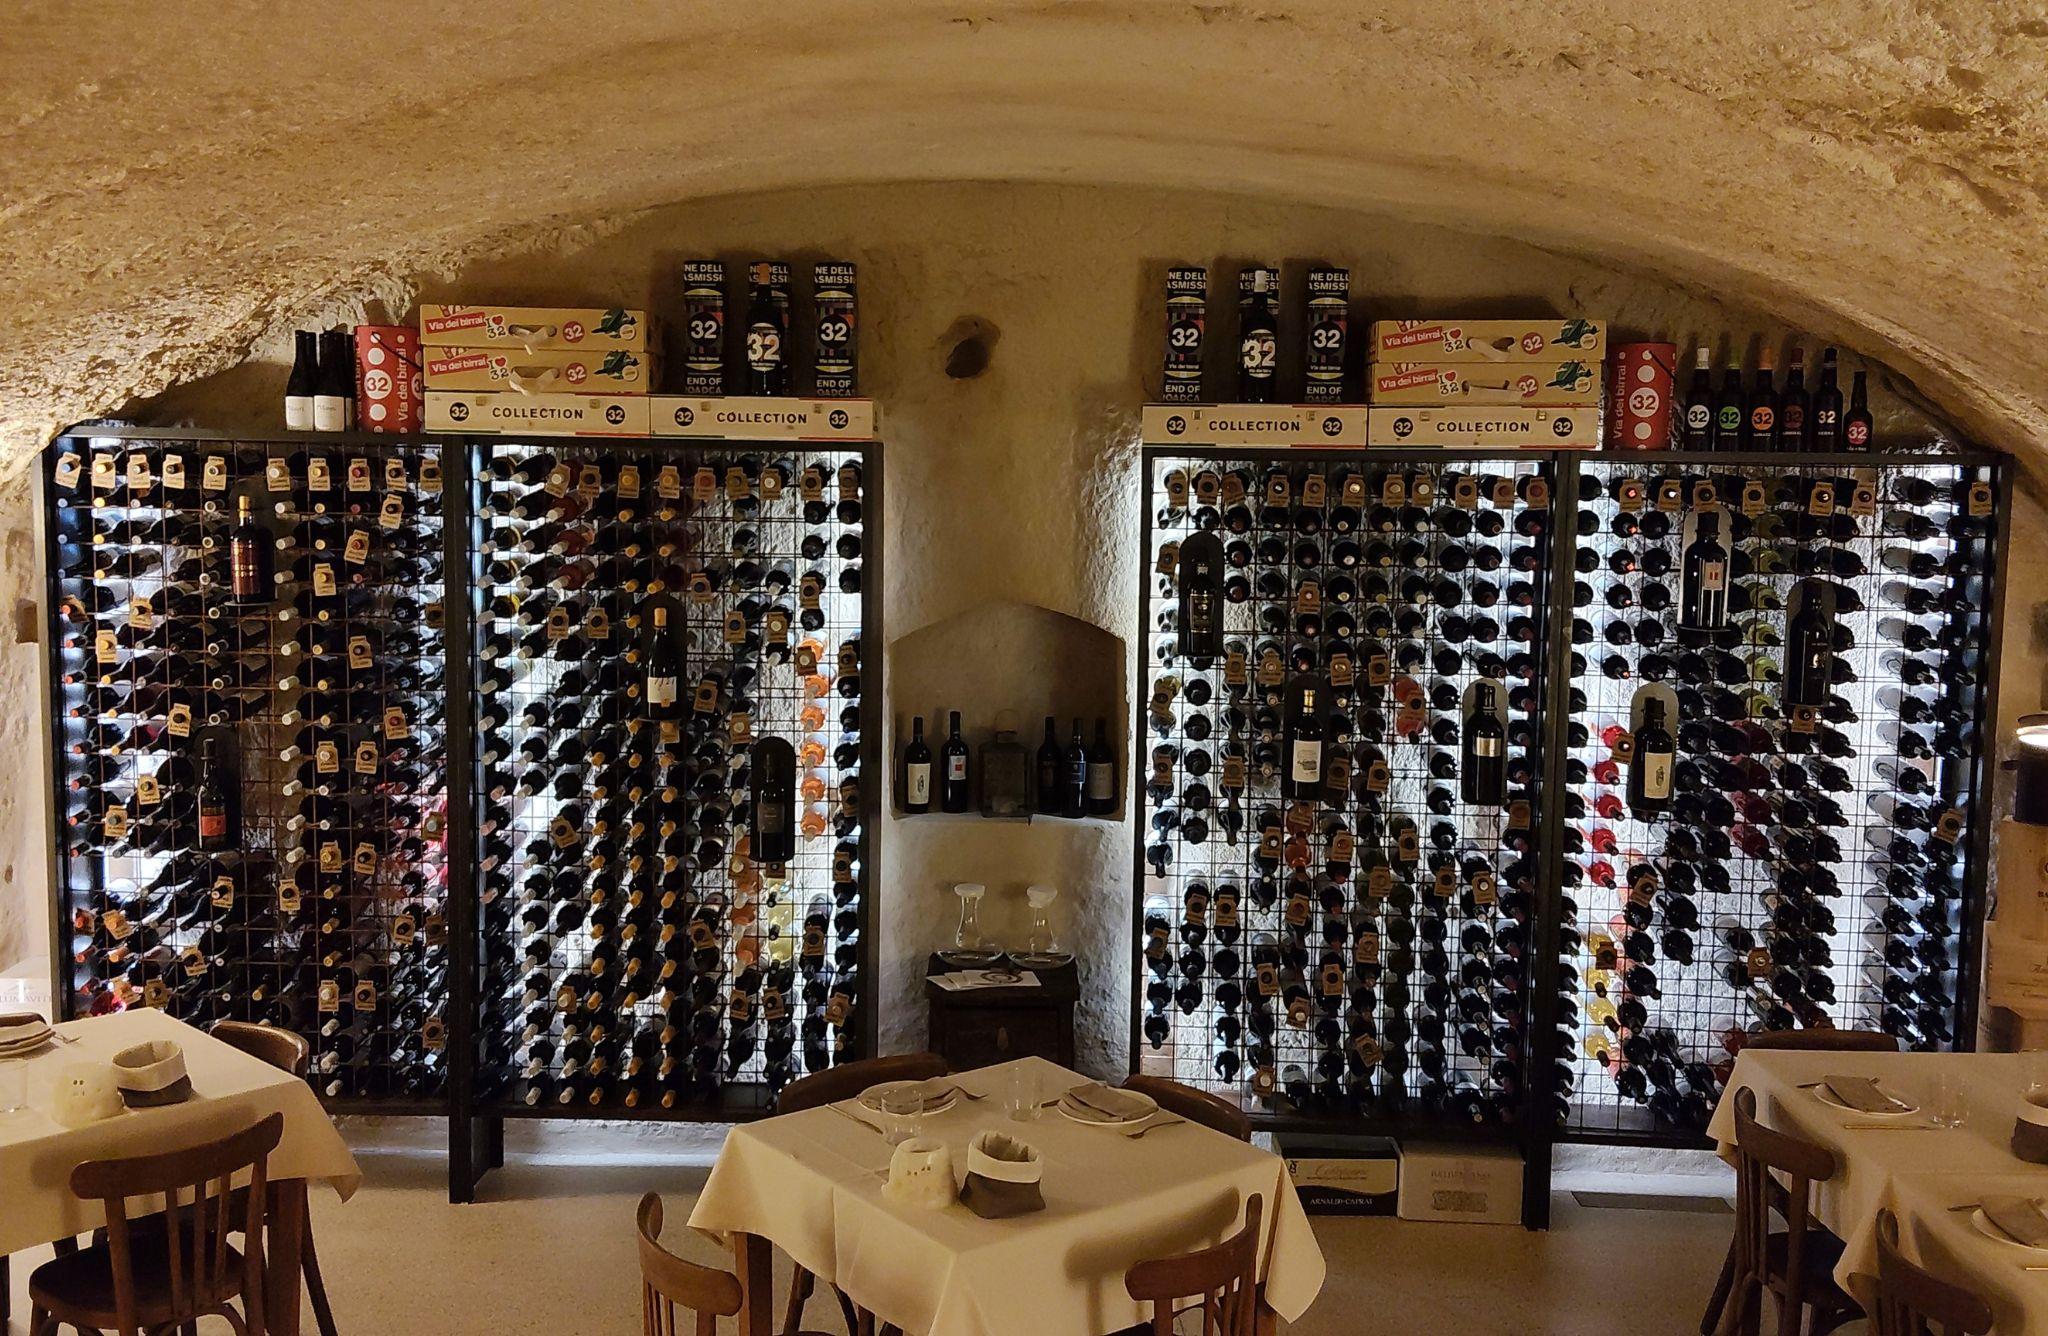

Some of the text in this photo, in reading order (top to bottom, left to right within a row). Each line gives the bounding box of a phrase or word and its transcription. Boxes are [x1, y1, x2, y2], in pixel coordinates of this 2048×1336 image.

[428, 321, 444, 331] Via
[487, 326, 506, 339] 32
[564, 324, 583, 339] 32
[690, 320, 717, 339] 32
[820, 322, 847, 341] 32
[1171, 328, 1198, 347] 32
[1313, 329, 1340, 348] 32
[1385, 337, 1400, 346] Via
[1523, 336, 1542, 350] 32
[747, 333, 780, 361] 32
[1444, 339, 1464, 352] 32
[1243, 340, 1276, 368] 32
[432, 363, 448, 372] Via
[490, 368, 509, 380] 32
[567, 366, 586, 381] 32
[366, 377, 389, 392] 32
[687, 377, 722, 386] END OF
[817, 379, 851, 387] END OF
[1381, 379, 1396, 388] Via
[1440, 381, 1459, 395] 32
[1519, 379, 1538, 394] 32
[397, 381, 408, 400] dei
[1165, 385, 1200, 393] END OF
[1306, 386, 1342, 394] END OF
[1615, 398, 1624, 417] dei
[1632, 395, 1656, 410] 32
[397, 402, 408, 421] Via
[451, 406, 624, 420] 32 COLLECTION 32
[676, 411, 847, 425] 32 COLLECTION 32
[1689, 411, 1707, 423] 32
[1720, 412, 1739, 423] 32
[1753, 413, 1772, 424] 32
[1784, 411, 1802, 422] 32
[1818, 410, 1836, 424] 32
[1168, 420, 1340, 432] 32 COLLECTION 32
[1395, 421, 1571, 433] 32 COLLECTION 32
[1613, 419, 1623, 439] Via
[1848, 426, 1868, 440] 32
